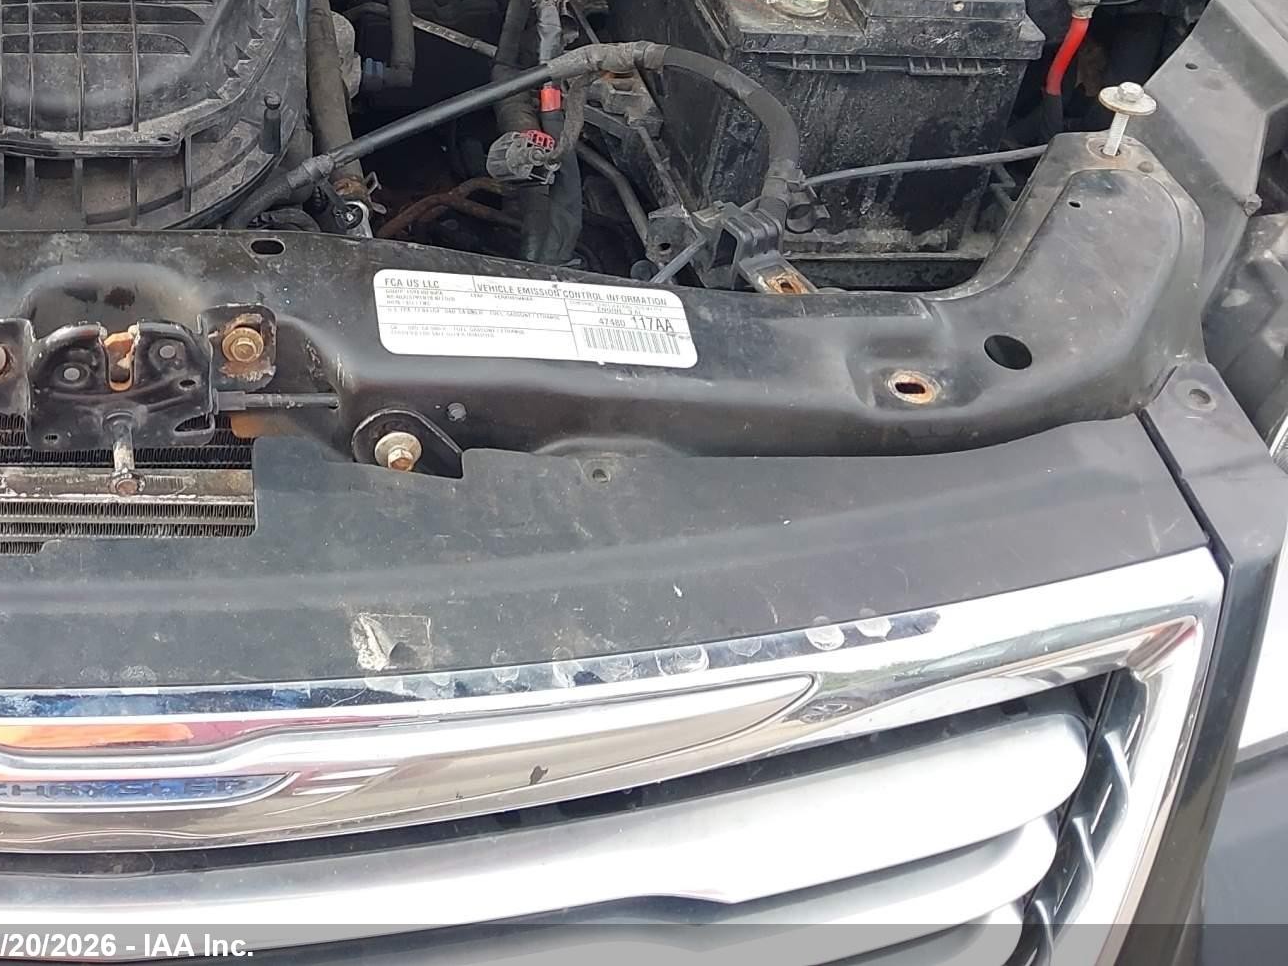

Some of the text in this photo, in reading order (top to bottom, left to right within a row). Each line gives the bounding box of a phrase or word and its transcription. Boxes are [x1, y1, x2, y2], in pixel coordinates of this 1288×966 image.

[384, 277, 440, 289] FCA US LLC
[477, 283, 513, 295] VEHICLE
[517, 286, 561, 298] EMISSION
[562, 290, 603, 301] CONTROL
[606, 293, 668, 307] INFORMATION
